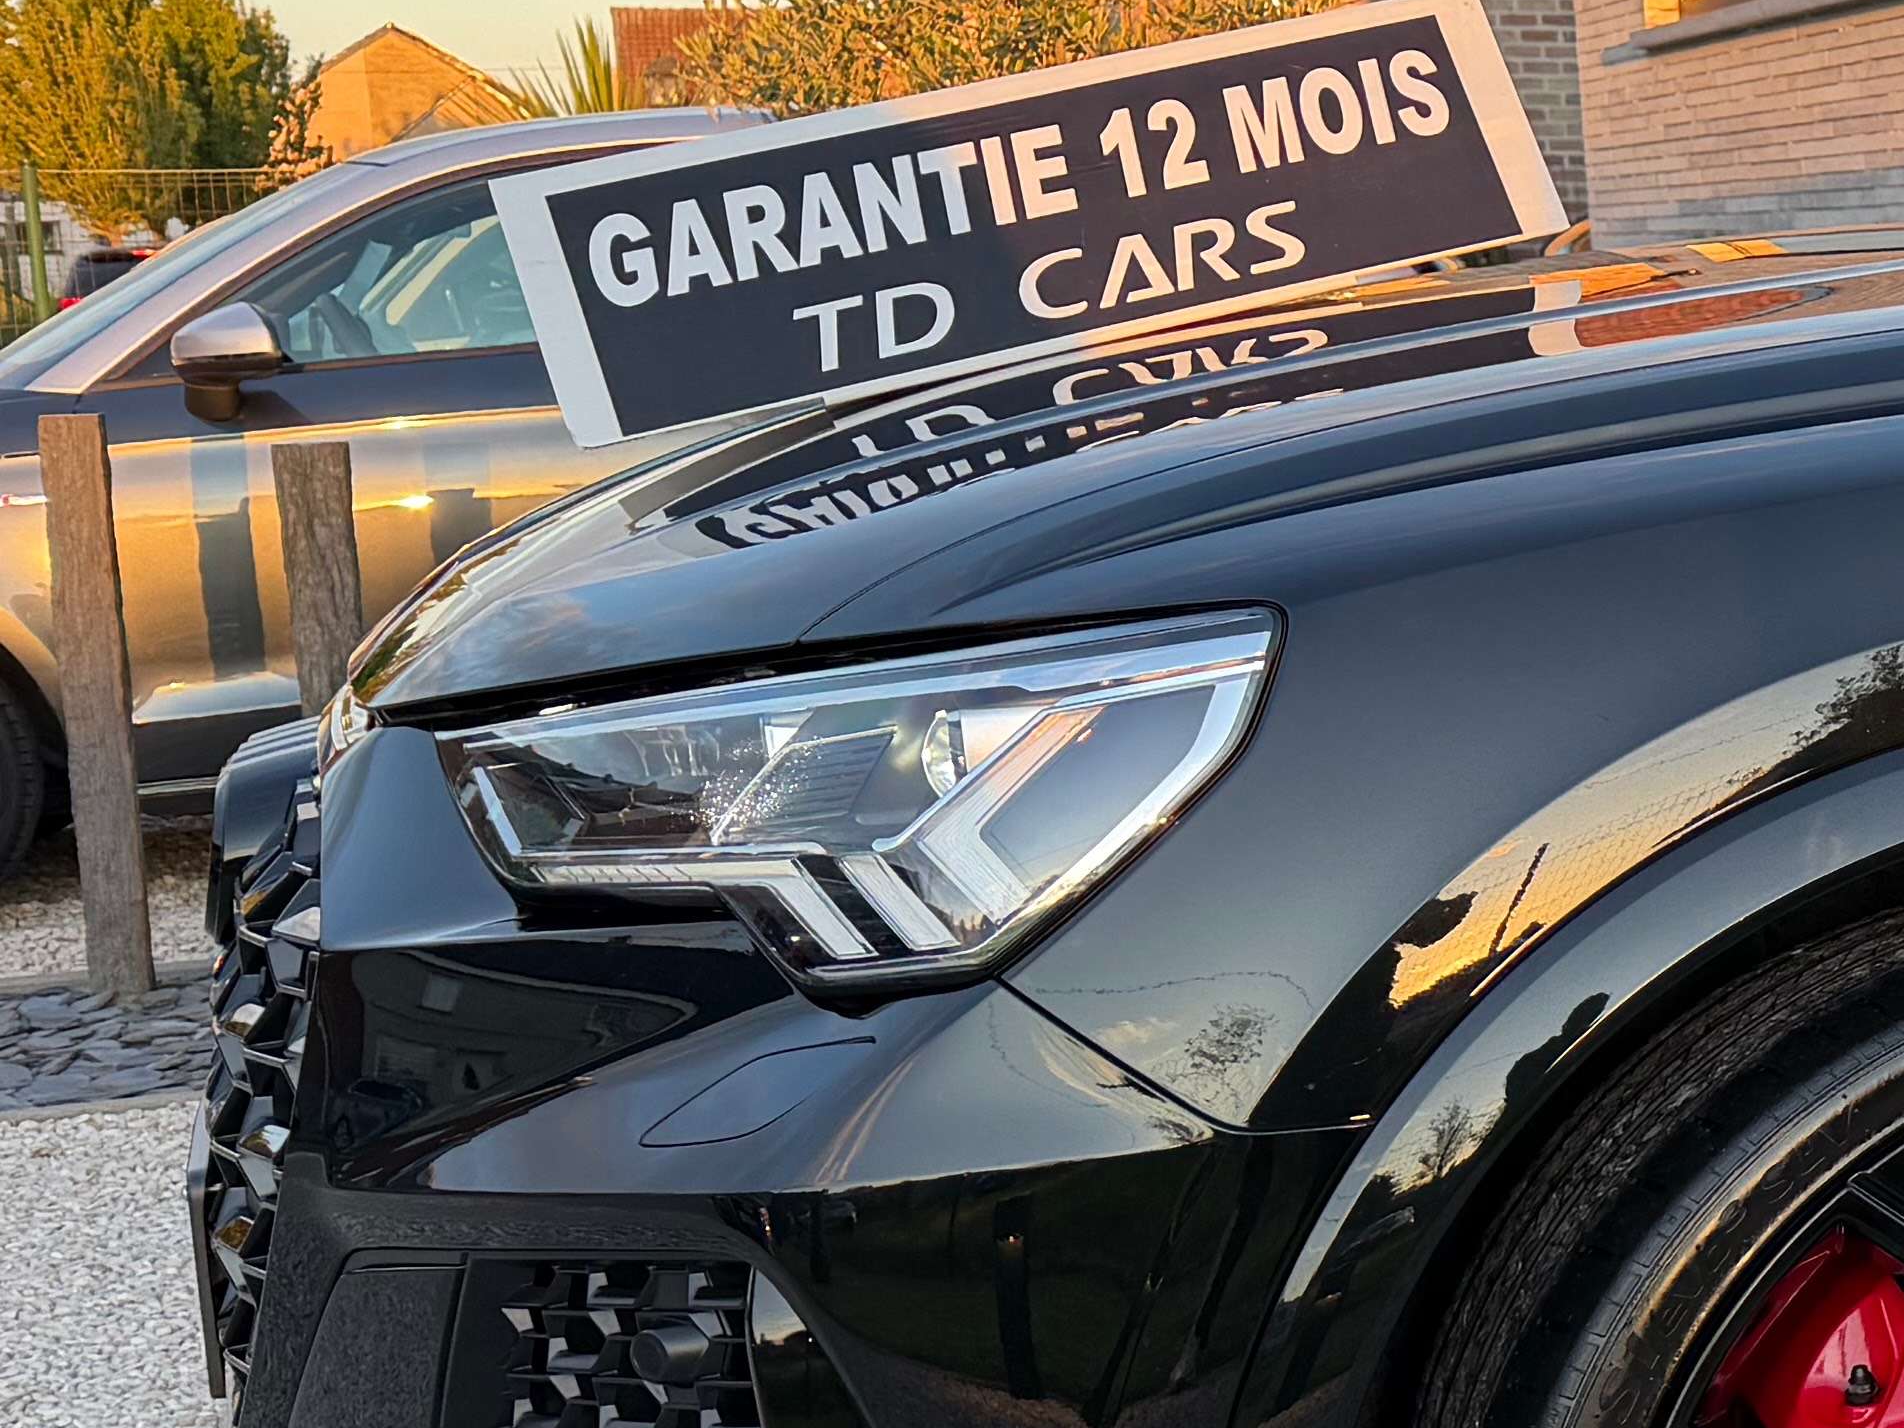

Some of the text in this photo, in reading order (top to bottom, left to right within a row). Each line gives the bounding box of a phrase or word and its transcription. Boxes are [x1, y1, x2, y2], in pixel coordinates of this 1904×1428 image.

[589, 49, 1450, 307] GARANTIE 12 MOIS
[793, 200, 1306, 372] TD CARS
